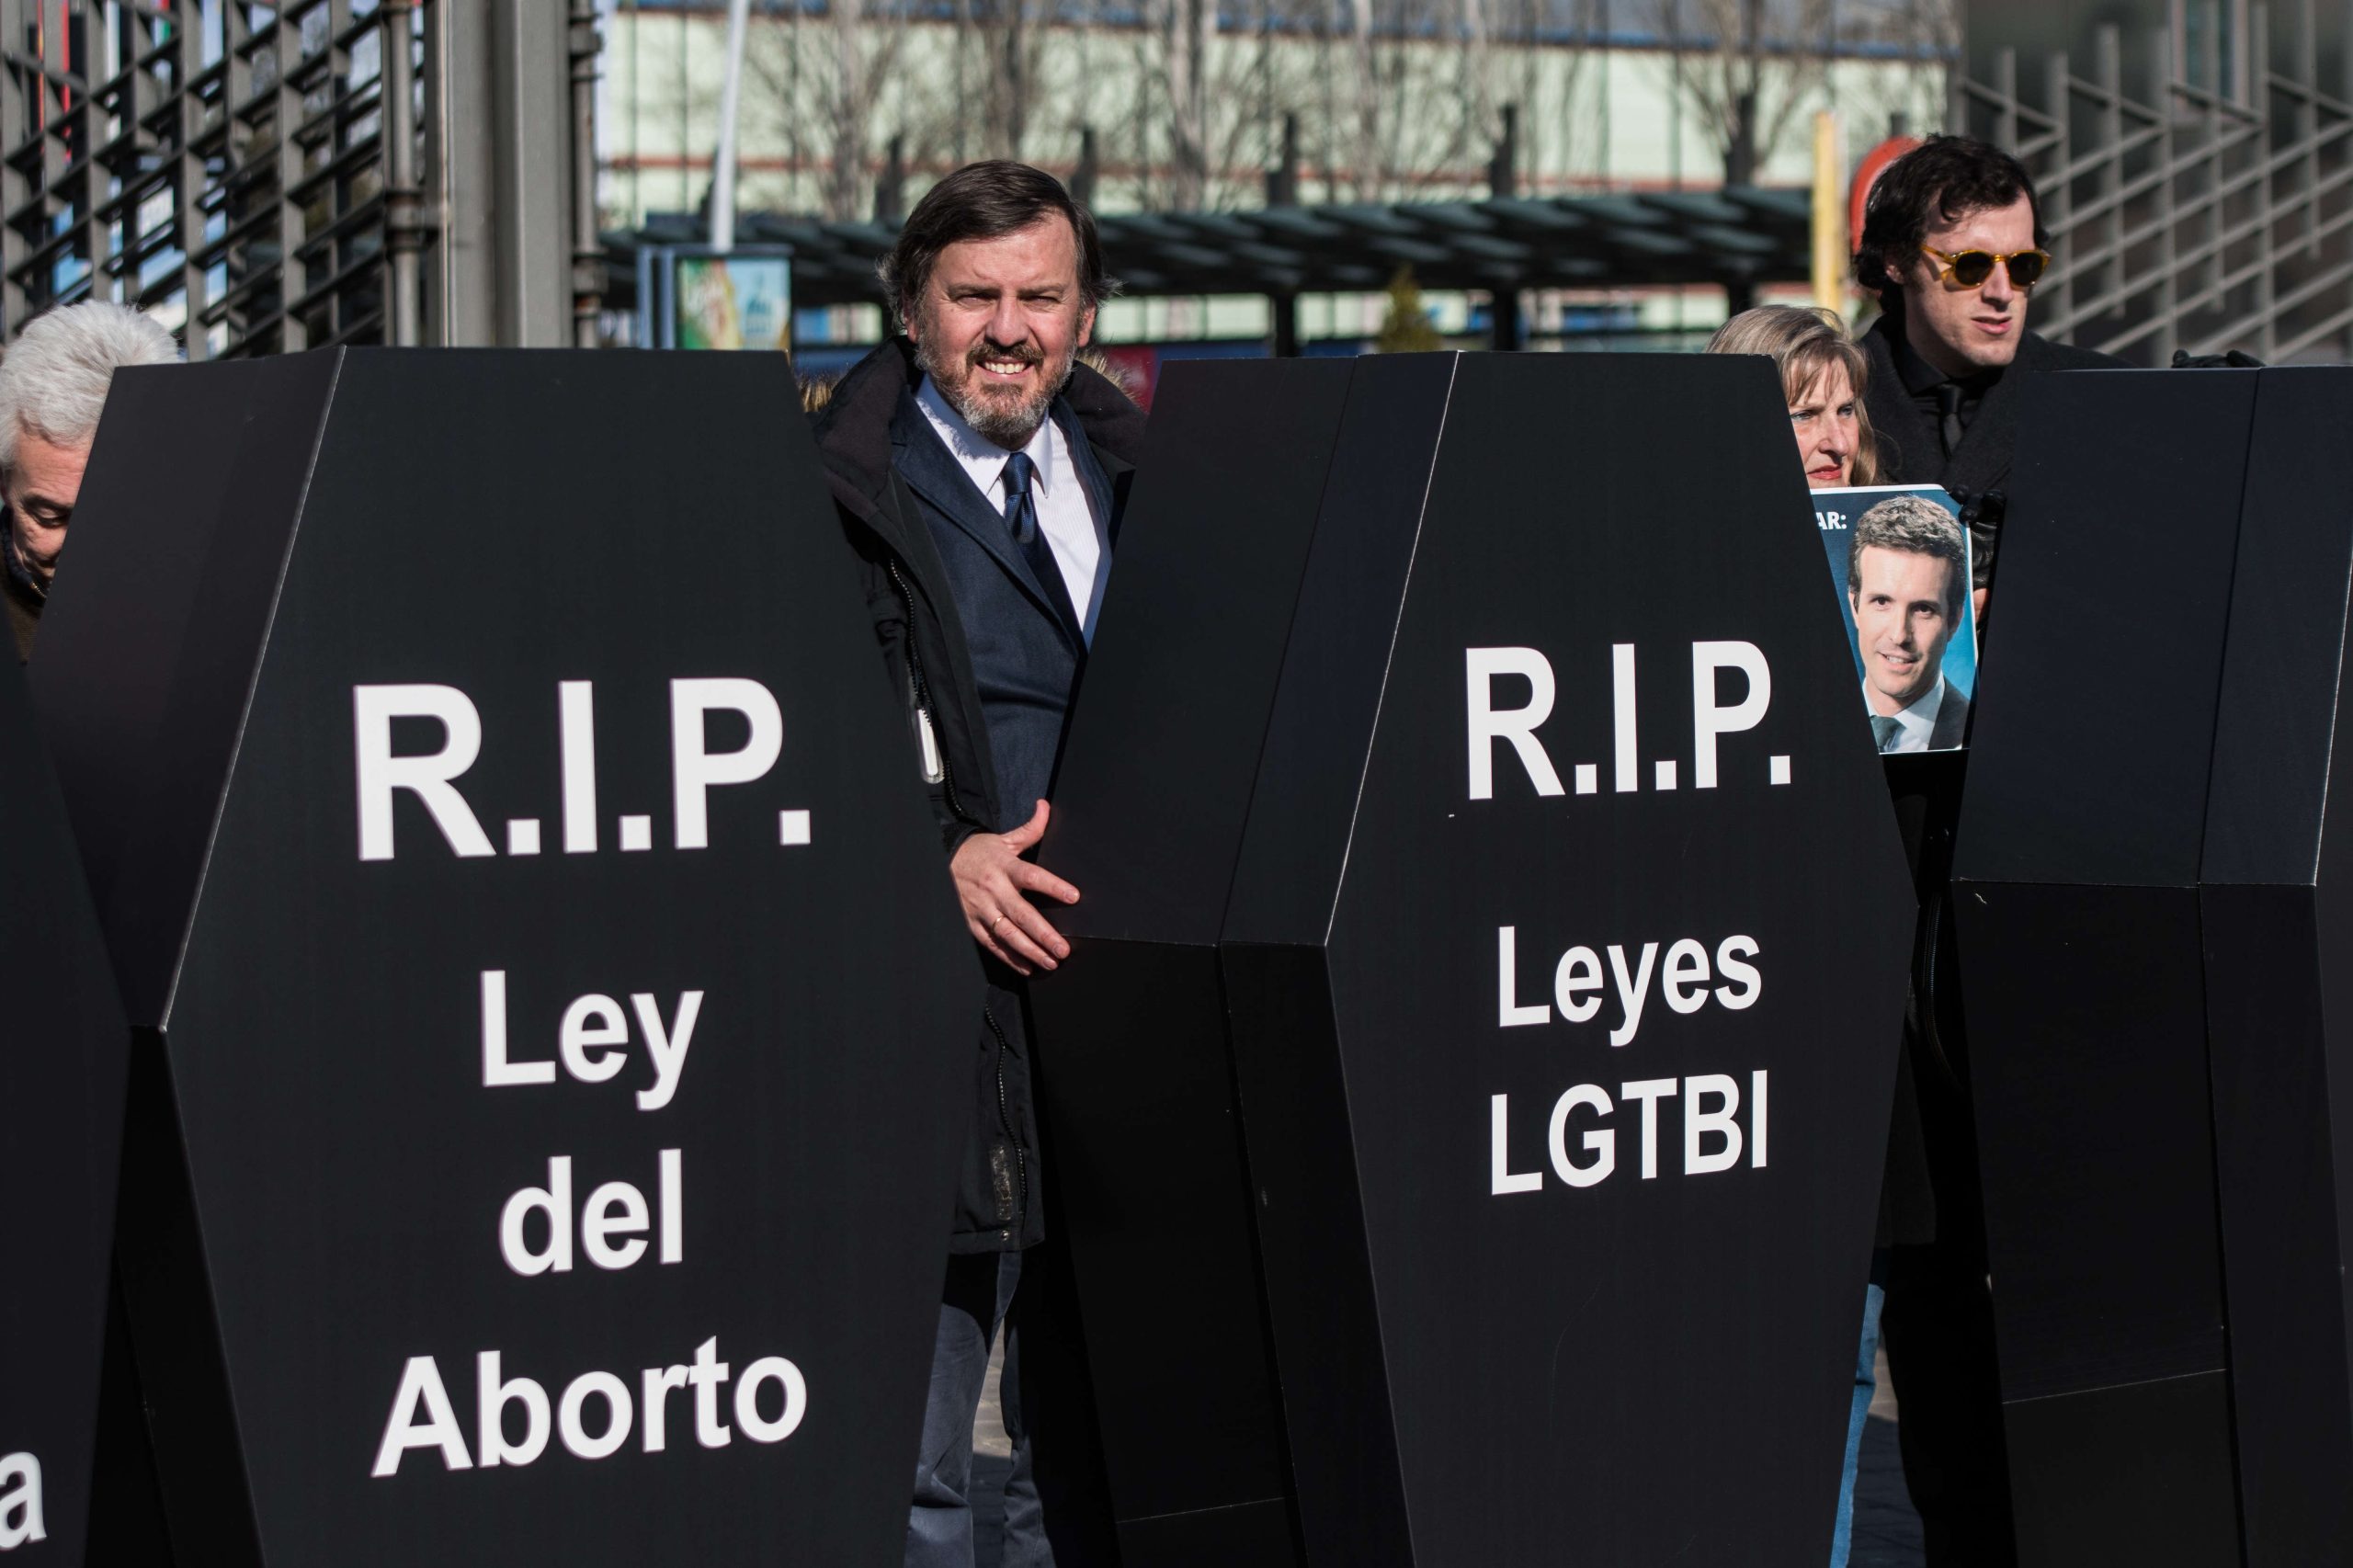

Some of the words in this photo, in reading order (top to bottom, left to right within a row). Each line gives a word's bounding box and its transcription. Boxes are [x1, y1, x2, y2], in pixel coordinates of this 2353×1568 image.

[354, 677, 813, 862] R.I.P.
[1465, 641, 1793, 801] R.I.P.
[481, 970, 704, 1111] Ley
[1497, 926, 1762, 1048] Leyes
[1491, 1069, 1768, 1197] LGTBI
[499, 1148, 683, 1277] del
[370, 1335, 808, 1478] Aborto
